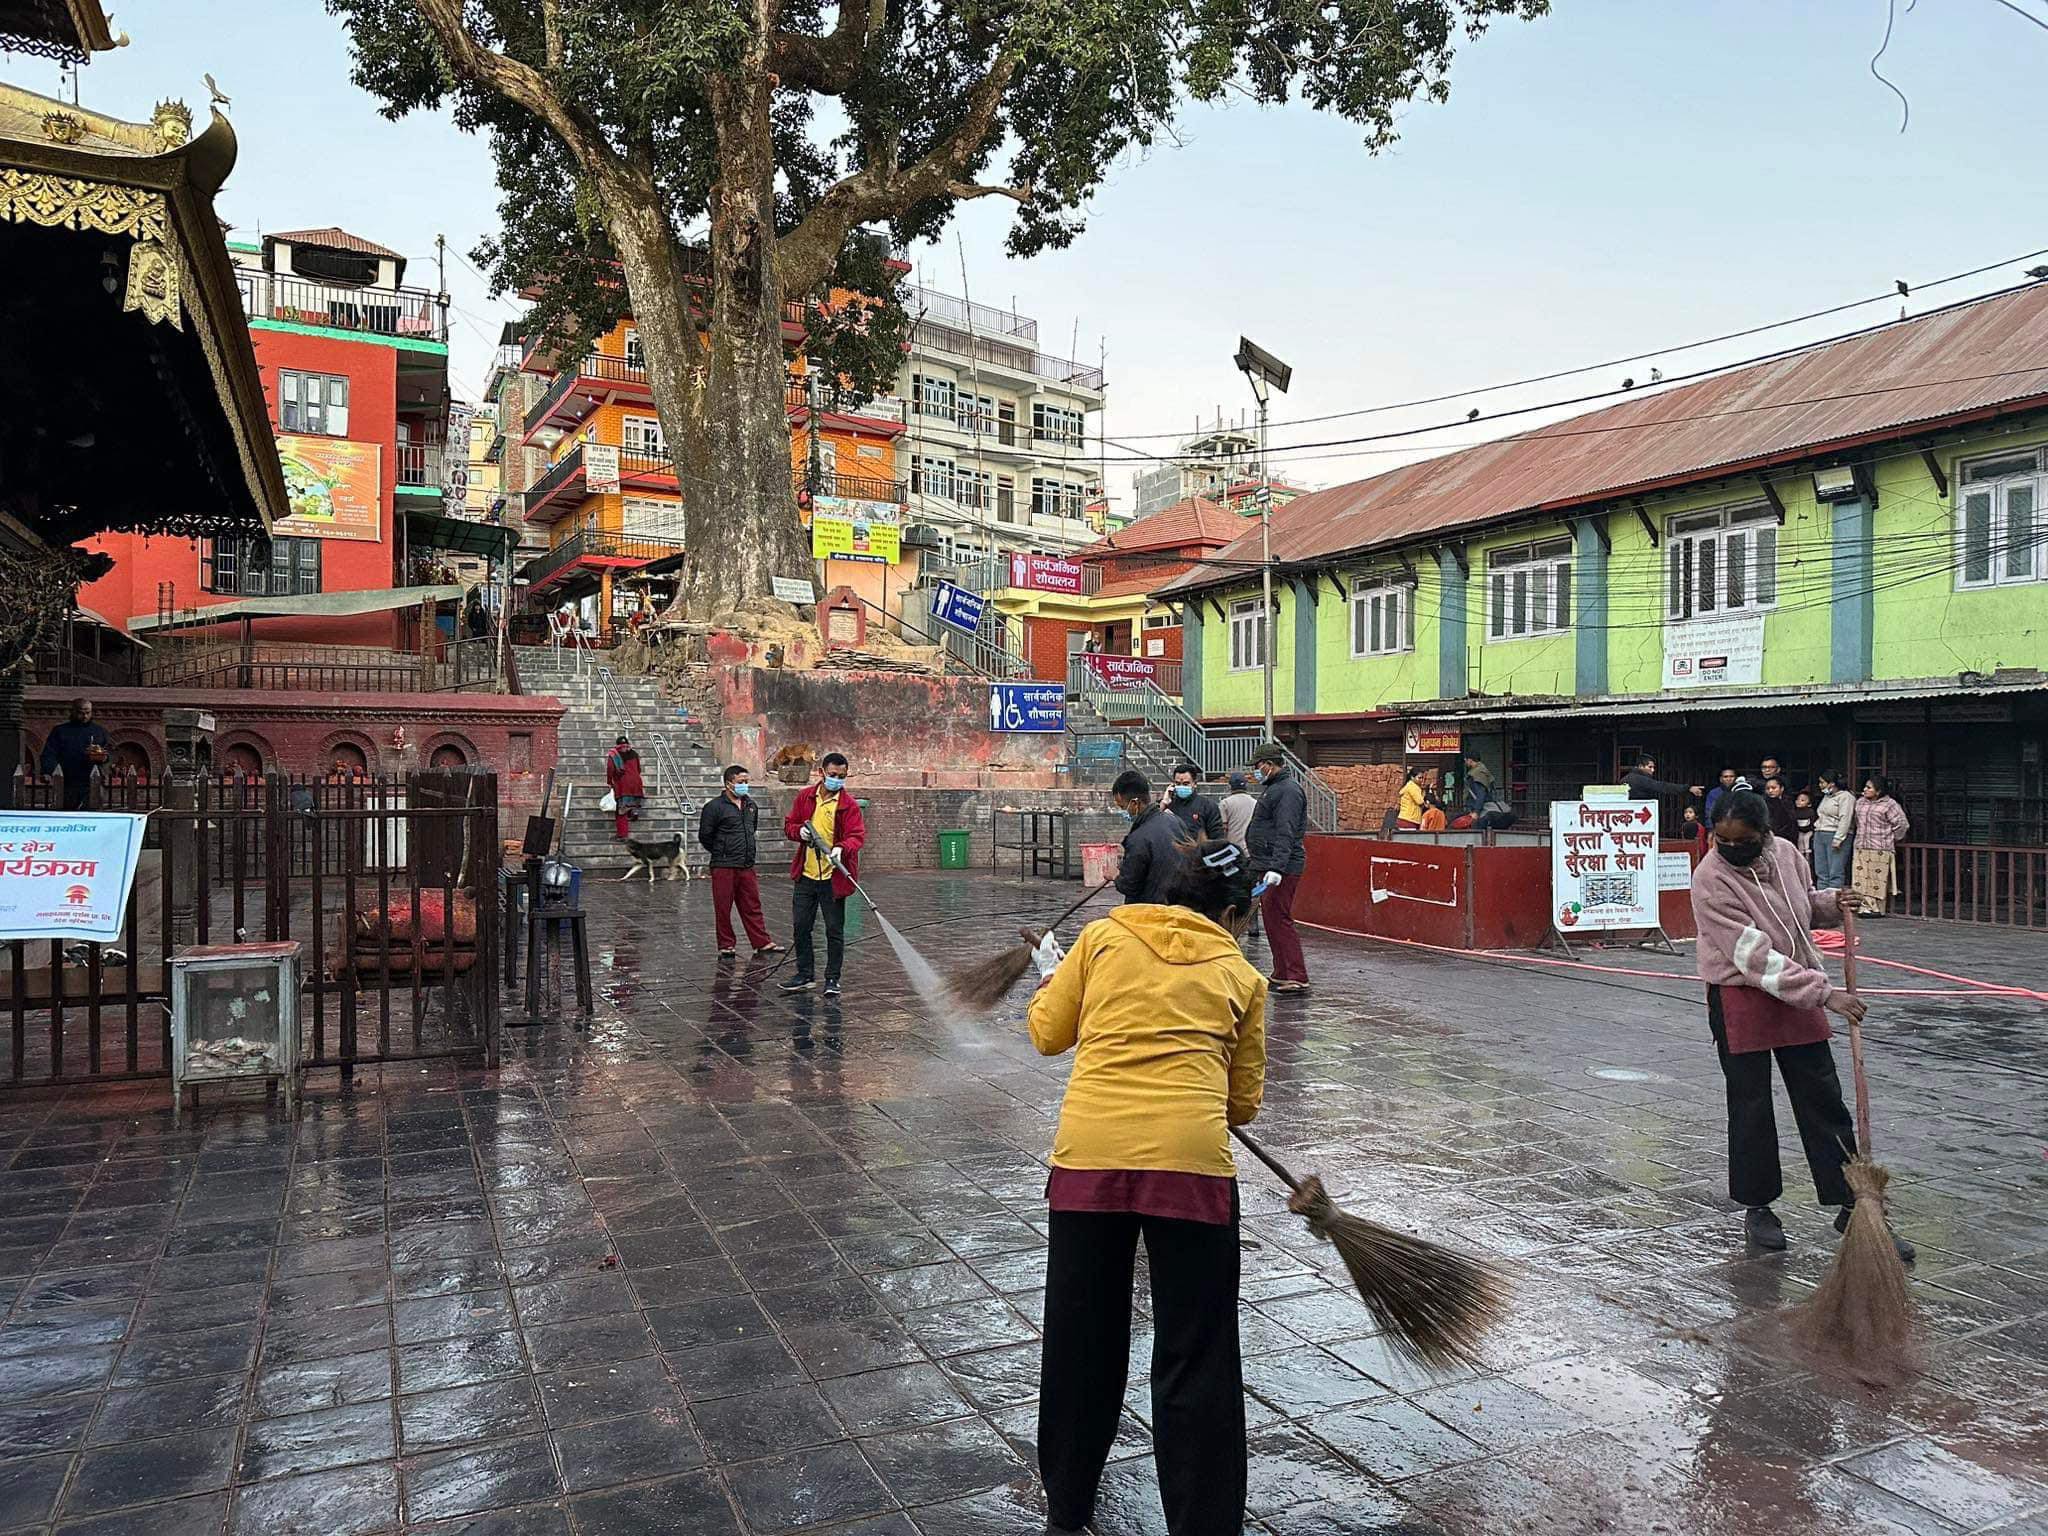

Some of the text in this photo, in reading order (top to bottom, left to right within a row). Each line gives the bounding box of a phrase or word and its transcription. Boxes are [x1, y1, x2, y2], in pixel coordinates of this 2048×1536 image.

[1031, 559, 1080, 575] सार्वजनिक
[955, 593, 982, 611] सार्वजनिक
[1106, 659, 1155, 674] सार्वजनिक
[1022, 689, 1064, 702] सार्वजनिक
[1027, 706, 1063, 720] शौचालय
[1578, 803, 1634, 832] निशुल्क
[44, 823, 97, 833] आयोजित
[1563, 831, 1655, 853] जुत्ता चप्पल
[0, 855, 100, 878] ार्यक्रम
[1564, 849, 1646, 877] सुरक्षा सेवा
